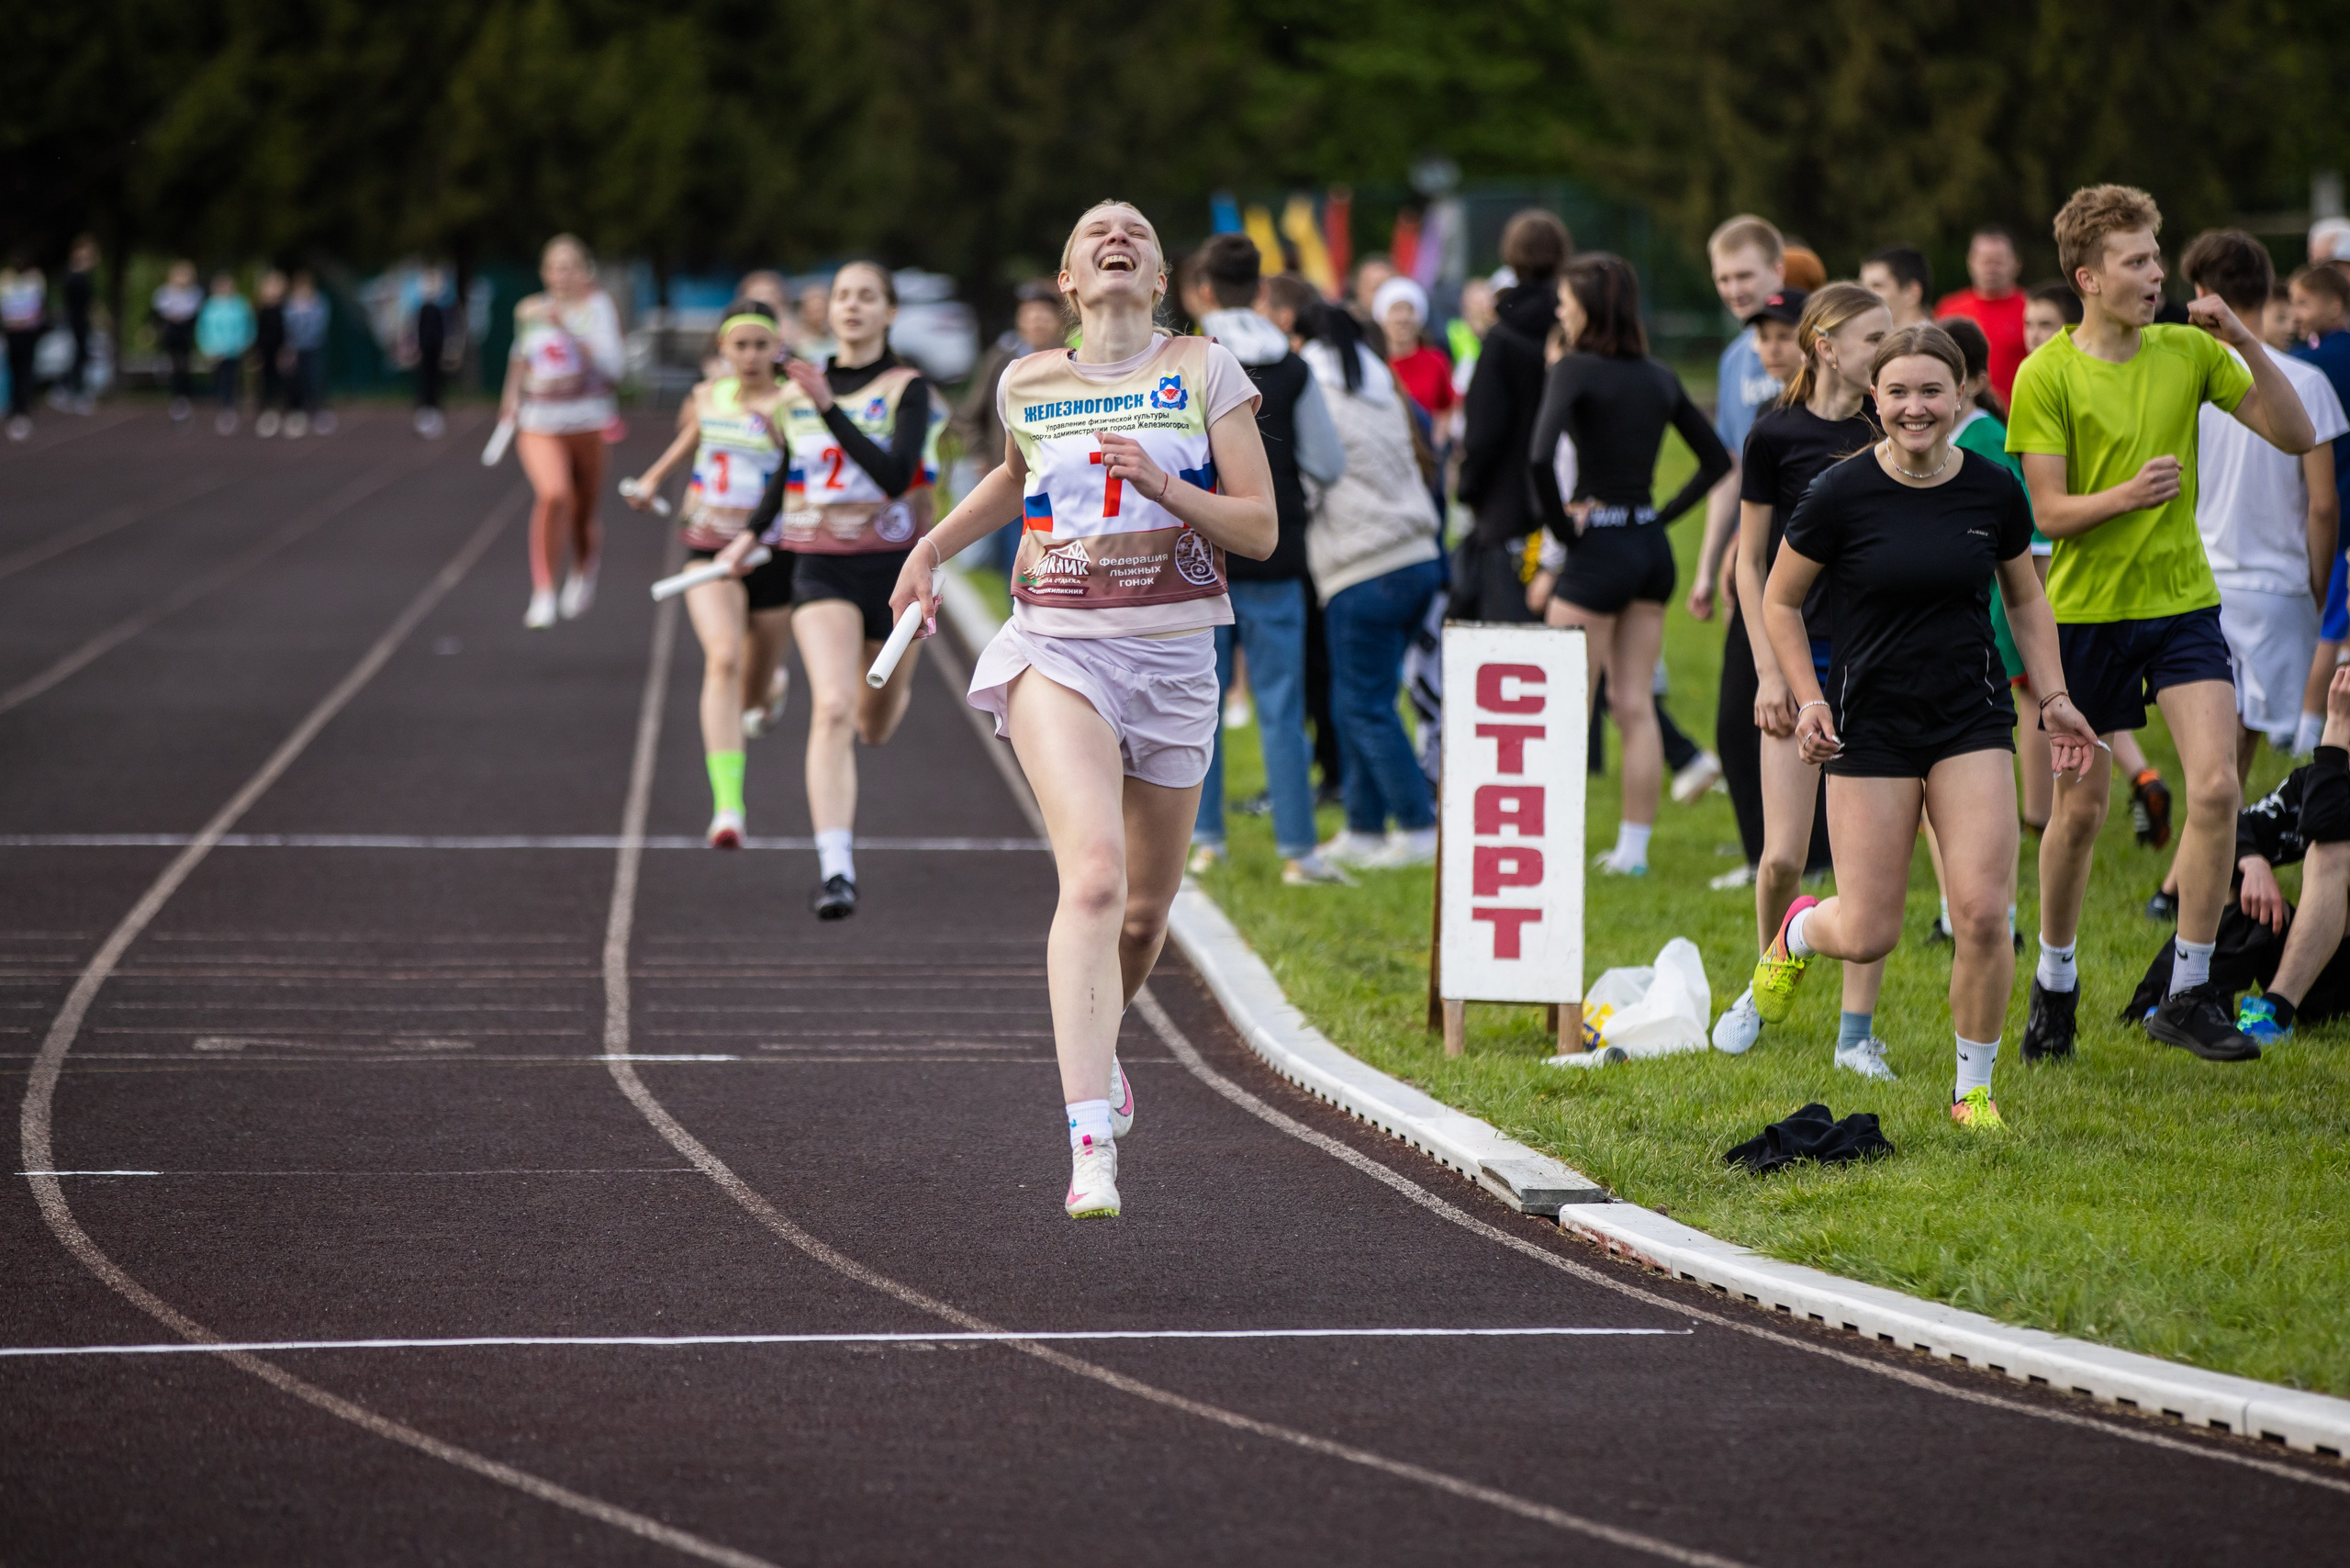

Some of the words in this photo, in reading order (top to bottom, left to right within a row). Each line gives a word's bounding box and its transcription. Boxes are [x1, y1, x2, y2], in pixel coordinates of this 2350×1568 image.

[1024, 394, 1145, 423] ЖЕЛЕЗНОГОРСК
[1046, 420, 1086, 432] Управление
[1088, 414, 1132, 427] физической
[1134, 412, 1169, 422] культуры
[1110, 423, 1136, 432] города
[711, 452, 729, 494] 3
[822, 445, 845, 490] 2
[1099, 554, 1169, 567] Федерация
[1110, 566, 1161, 577] лыжных
[1119, 577, 1155, 588] гонок
[1472, 663, 1547, 960] СТАРТ
